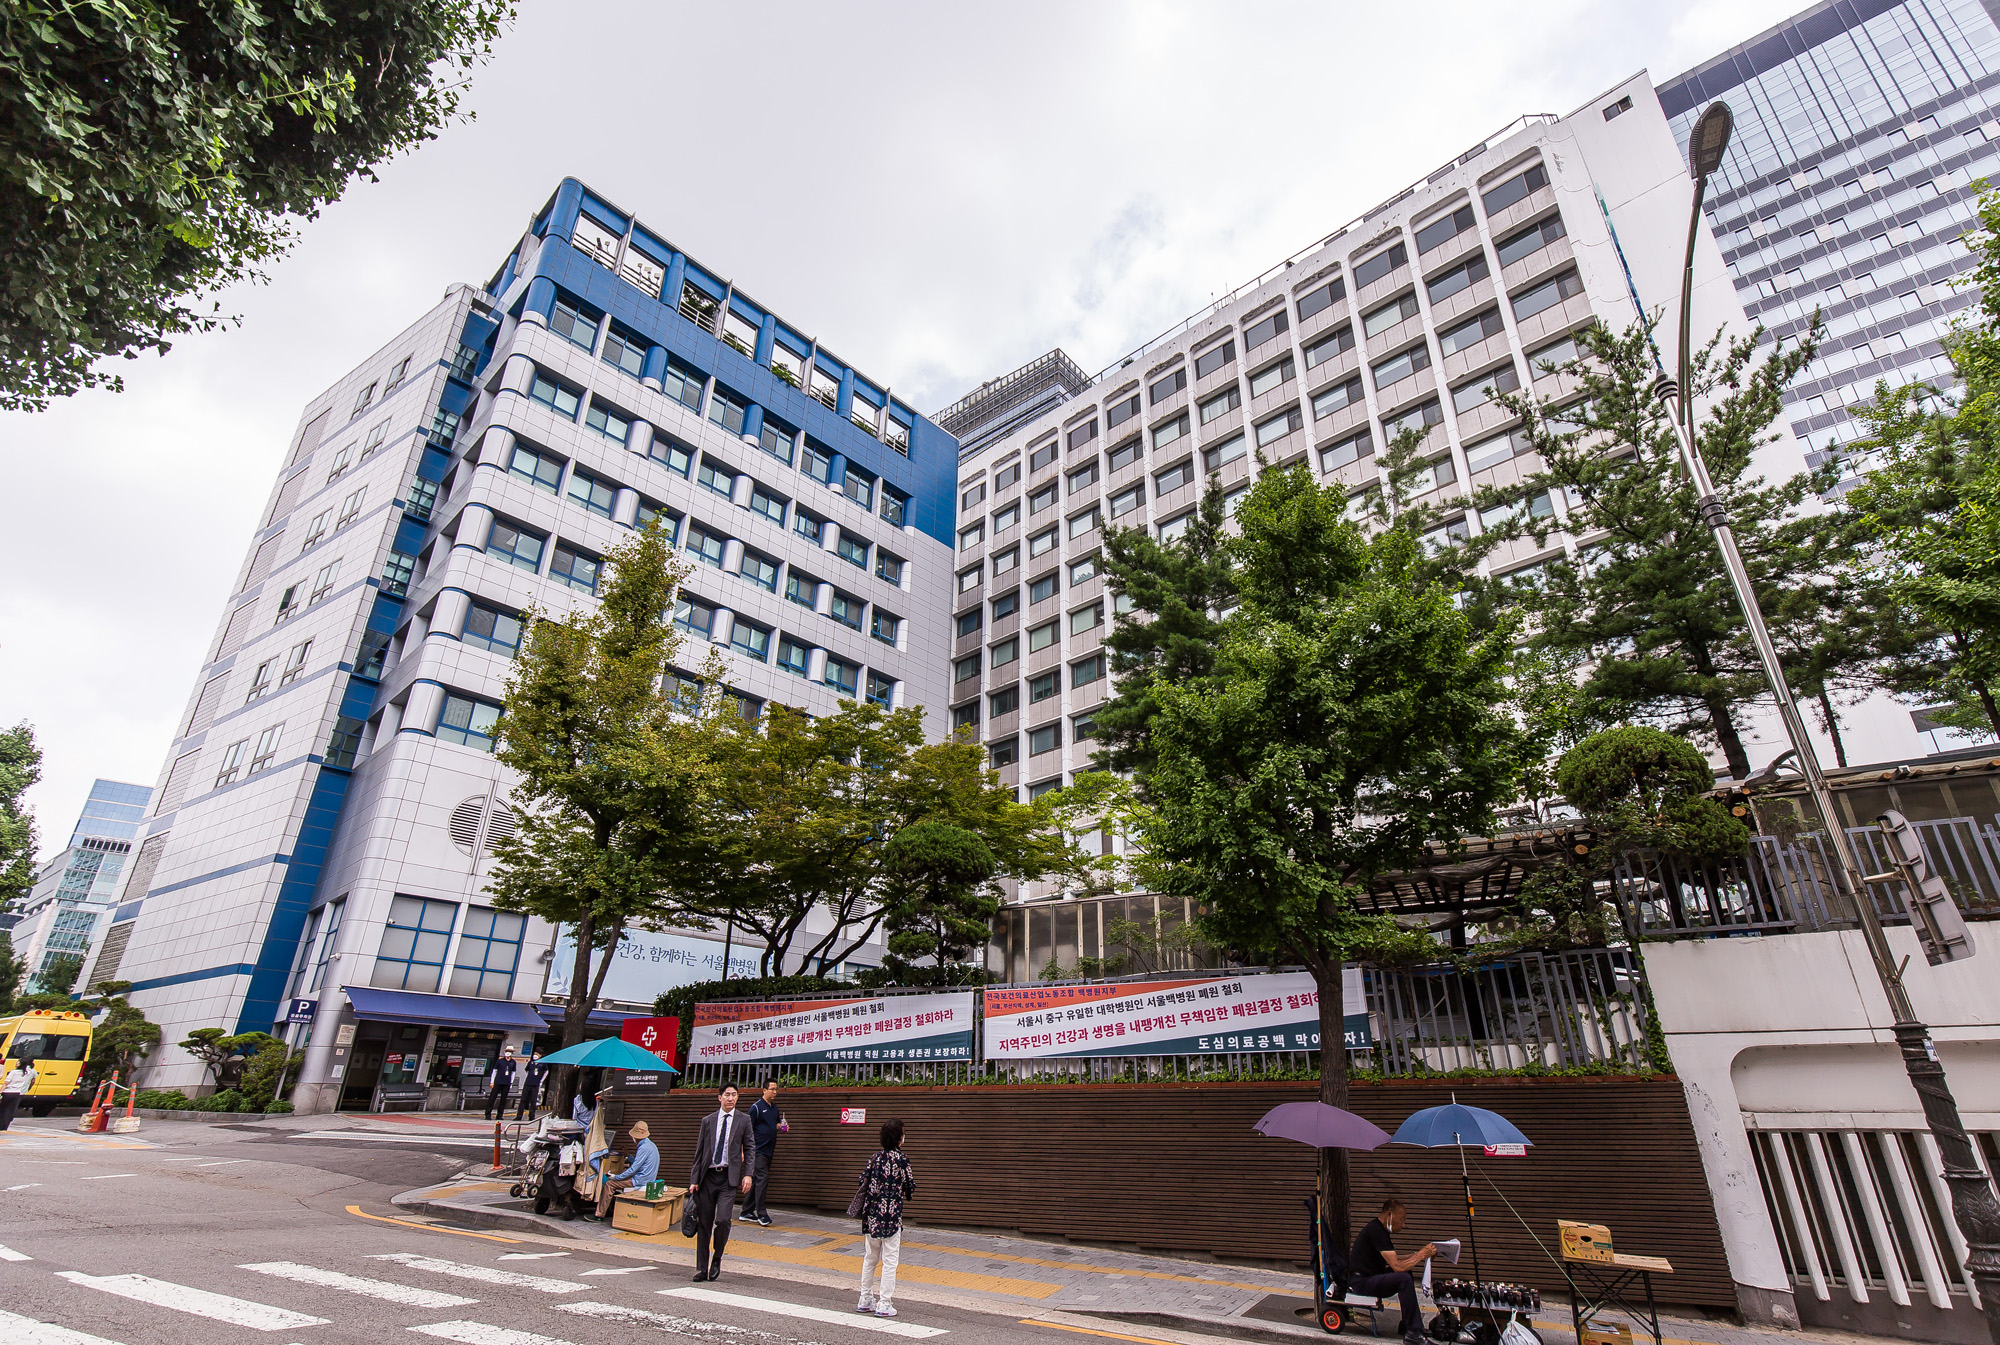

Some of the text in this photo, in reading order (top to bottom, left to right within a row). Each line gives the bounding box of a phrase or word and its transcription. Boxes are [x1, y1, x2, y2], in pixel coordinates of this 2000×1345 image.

[617, 942, 757, 976] 건강, 함께하는 서울백병원
[297, 1001, 310, 1013] P
[986, 987, 1117, 1001] 전국보건의료산업노동조합 백병원지부
[1016, 1014, 1043, 1028] 서울시
[1045, 1011, 1063, 1024] 중구
[1066, 1006, 1094, 1021] 유일한
[1096, 998, 1144, 1016] 대학병원인
[1147, 990, 1196, 1008] 서울백병원
[1221, 982, 1243, 996] 철회
[700, 1042, 739, 1057] 지역주민의
[741, 1039, 766, 1053] 건강과
[768, 1035, 795, 1049] 생명을
[797, 1028, 832, 1044] 내팽개친
[835, 1022, 872, 1039] 무책임한
[915, 1008, 954, 1026] 철회하라
[714, 1026, 735, 1037] 서울시
[736, 1024, 751, 1034] 중구
[752, 1021, 773, 1032] 유일한
[774, 1015, 811, 1029] 대학병원인
[813, 1007, 850, 1023] 서울백병원
[869, 1002, 885, 1014] 철회
[999, 1033, 1052, 1052] 지역주민의
[1055, 1027, 1088, 1045] 건강과
[1091, 1022, 1126, 1039] 생명을
[1129, 1014, 1177, 1033] 내팽개친
[1180, 1006, 1229, 1026] 무책임한
[825, 1046, 970, 1060] 서울백병원 직원 고용과 생존권 보장하라!
[1198, 1034, 1285, 1050] 도심의료공백
